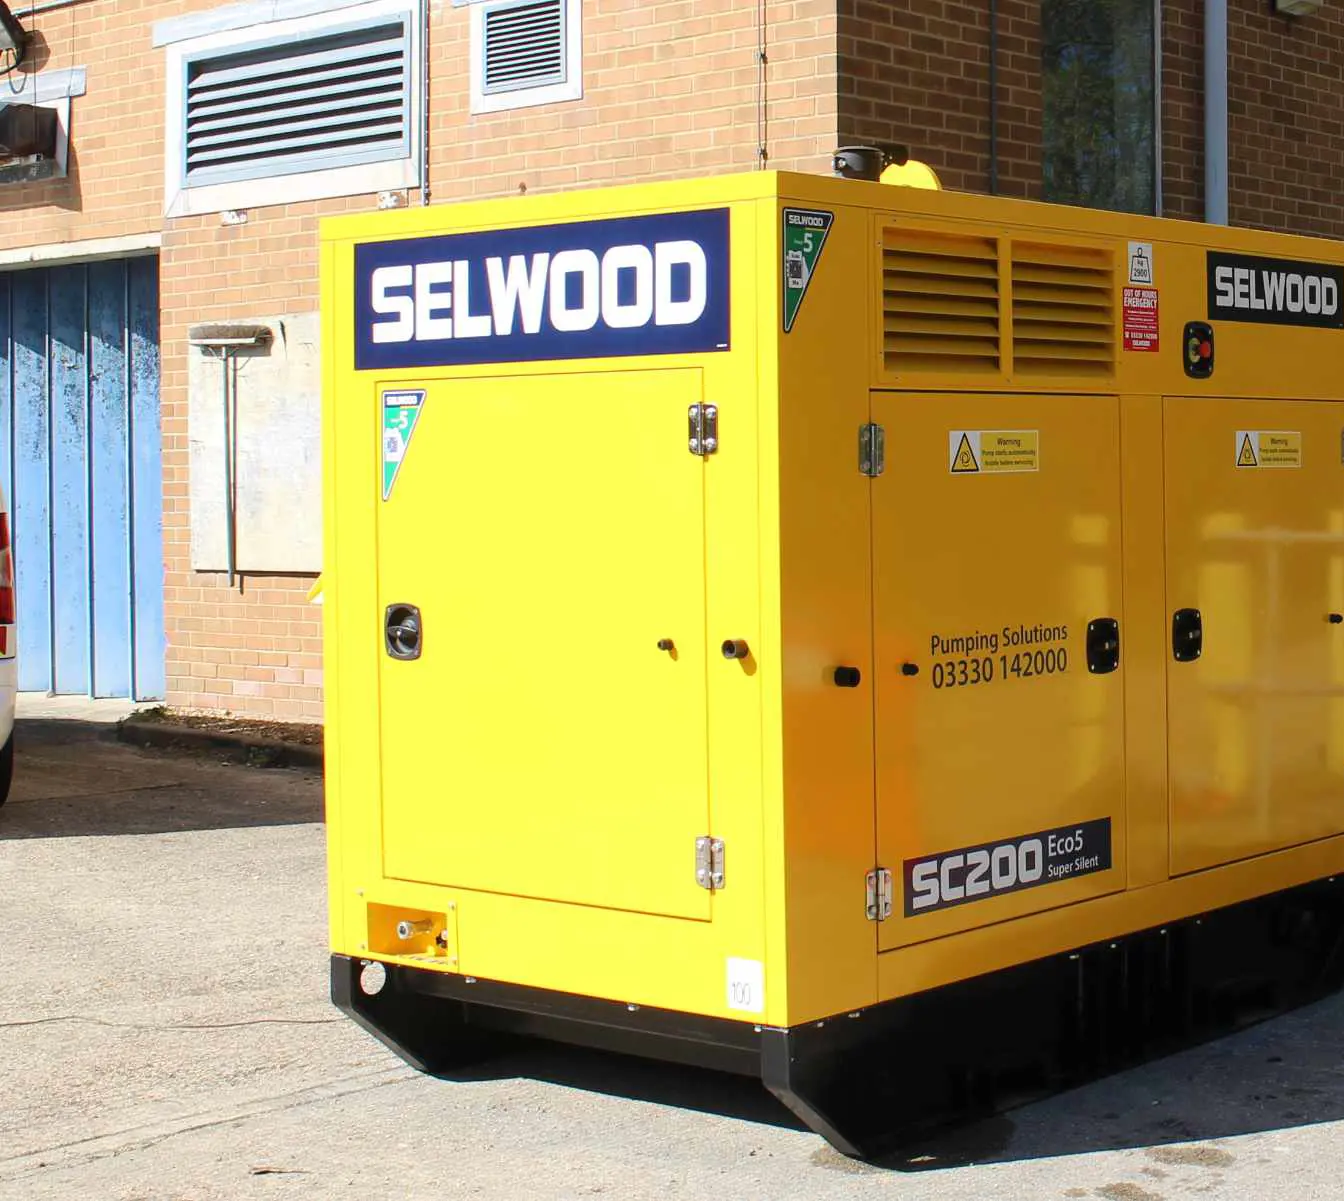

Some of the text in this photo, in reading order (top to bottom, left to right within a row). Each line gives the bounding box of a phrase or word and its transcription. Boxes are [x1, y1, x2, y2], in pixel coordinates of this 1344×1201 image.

[788, 214, 824, 227] SELWOOD
[803, 233, 813, 253] 5
[371, 240, 707, 344] SELWOOD
[1124, 297, 1158, 309] EMERGENCY
[1215, 266, 1338, 316] SELWOOD
[997, 438, 1021, 448] Warning
[931, 624, 1068, 656] Pumping Solutions
[932, 648, 1067, 689] 03330 142000
[912, 830, 1083, 910] SC200 Eco5
[1048, 856, 1099, 878] Super Silent
[731, 981, 751, 1005] 100
